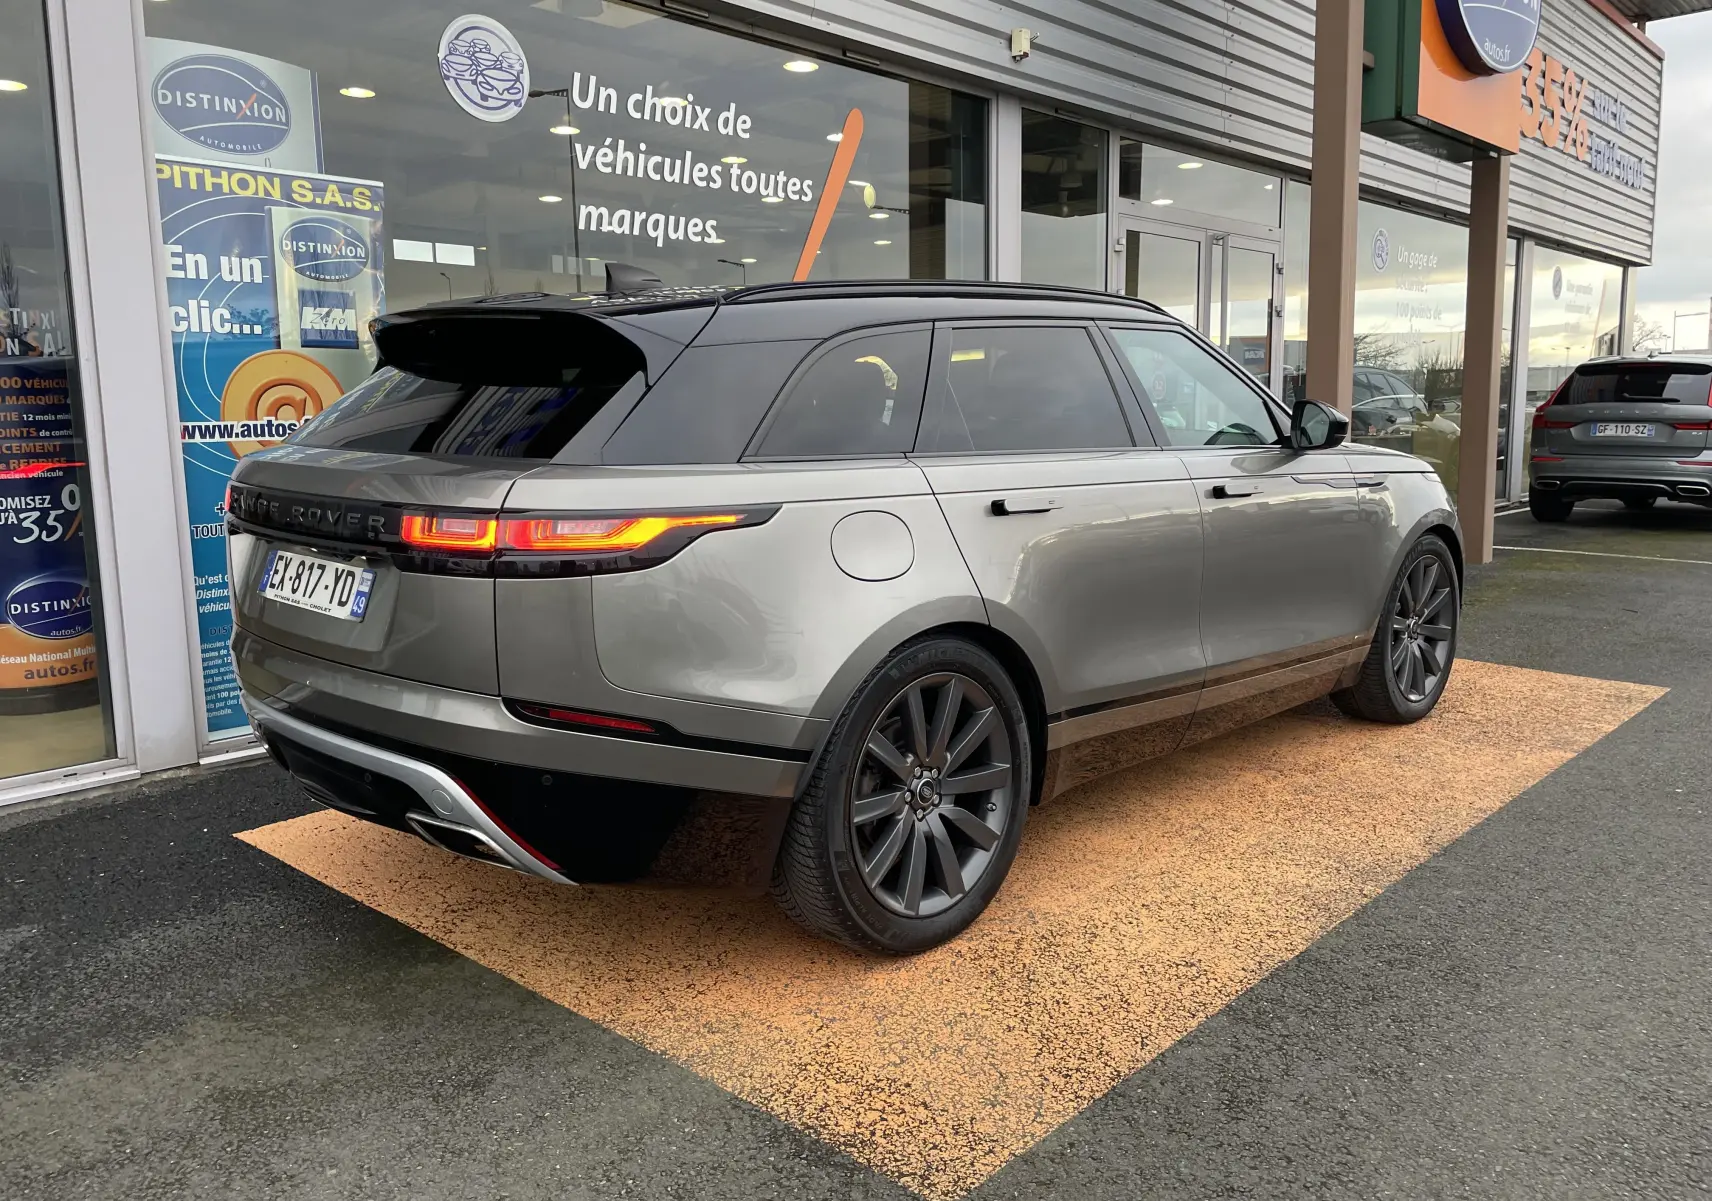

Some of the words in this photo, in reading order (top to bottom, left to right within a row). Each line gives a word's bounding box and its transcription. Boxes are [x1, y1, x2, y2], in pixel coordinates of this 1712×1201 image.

[1484, 38, 1510, 62] autos.fr
[158, 89, 286, 122] DISTINXION
[572, 71, 618, 114] Un
[626, 85, 711, 131] choix
[718, 102, 751, 138] de
[1520, 48, 1588, 161] 35%
[200, 136, 262, 150] AUTOMOBILE
[575, 137, 722, 189] véhicules
[730, 163, 813, 201] toutes
[156, 164, 281, 200] PITHON
[291, 180, 380, 212] S.A.S.
[578, 204, 717, 247] marques
[283, 240, 365, 258] DISTINXION
[1397, 245, 1408, 263] Un
[1409, 252, 1427, 270] gage
[1428, 252, 1438, 268] de
[163, 244, 208, 280] En
[220, 256, 262, 283] un
[306, 271, 348, 280] AUTOMOBILE
[169, 300, 262, 334] clic...
[0, 377, 22, 389] 00
[6, 394, 65, 405] MARQUES
[35, 413, 55, 421] mois
[39, 429, 50, 437] de
[181, 418, 311, 440] www.autos
[1597, 424, 1647, 435] GF-110-SZ
[0, 442, 61, 454] CEMENT
[291, 505, 385, 533] ROVER
[268, 554, 356, 607] EX-817-YD
[196, 587, 230, 600] Distinx
[199, 601, 232, 614] véhicu
[310, 603, 332, 613] CHOLET
[353, 595, 366, 613] 49
[50, 625, 81, 636] autos.fr
[30, 649, 71, 663] National
[24, 658, 95, 680] autos.fr
[216, 691, 229, 699] 100
